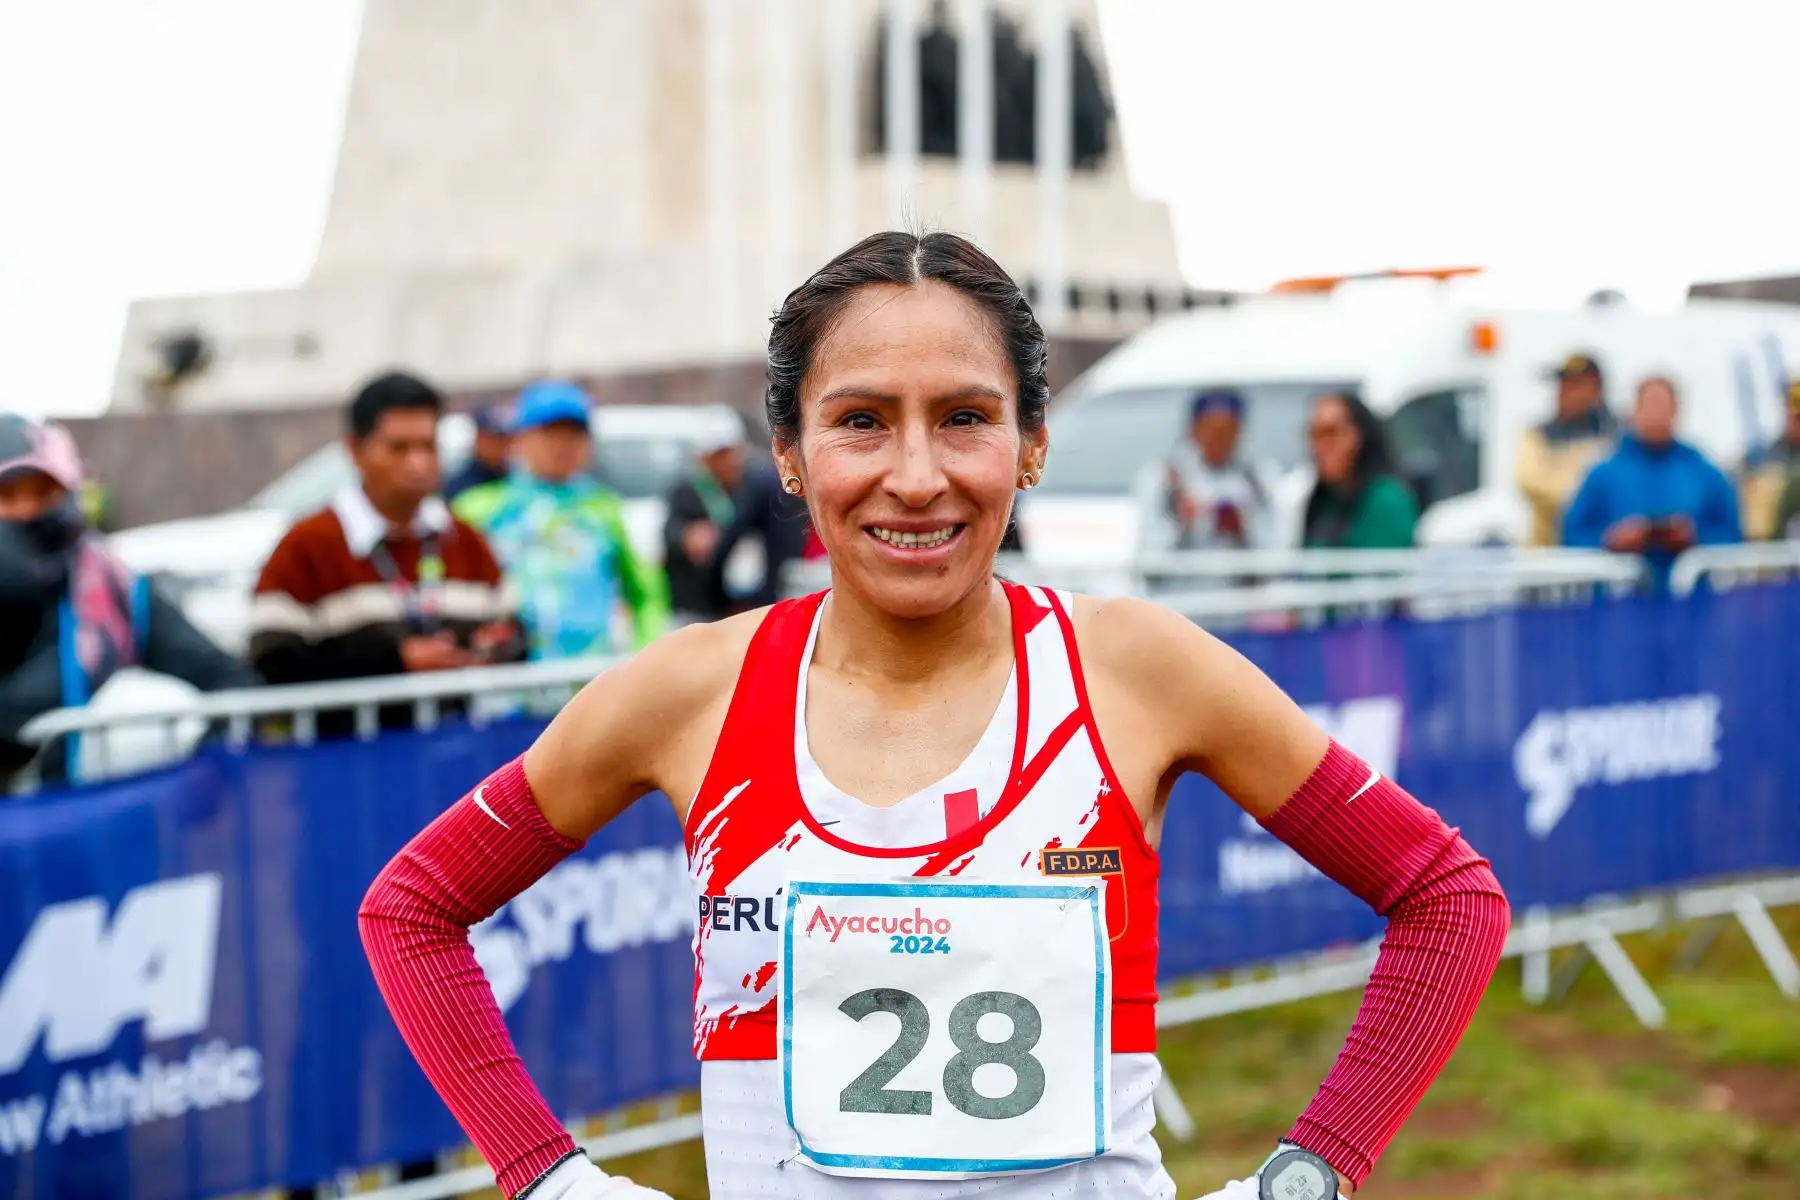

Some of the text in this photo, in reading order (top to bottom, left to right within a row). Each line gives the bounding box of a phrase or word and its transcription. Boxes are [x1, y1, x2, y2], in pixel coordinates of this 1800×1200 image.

[1050, 854, 1117, 871] F.D.P.A.
[806, 905, 951, 943] Ayacucho
[890, 935, 951, 954] 2024
[837, 987, 1046, 1120] 28
